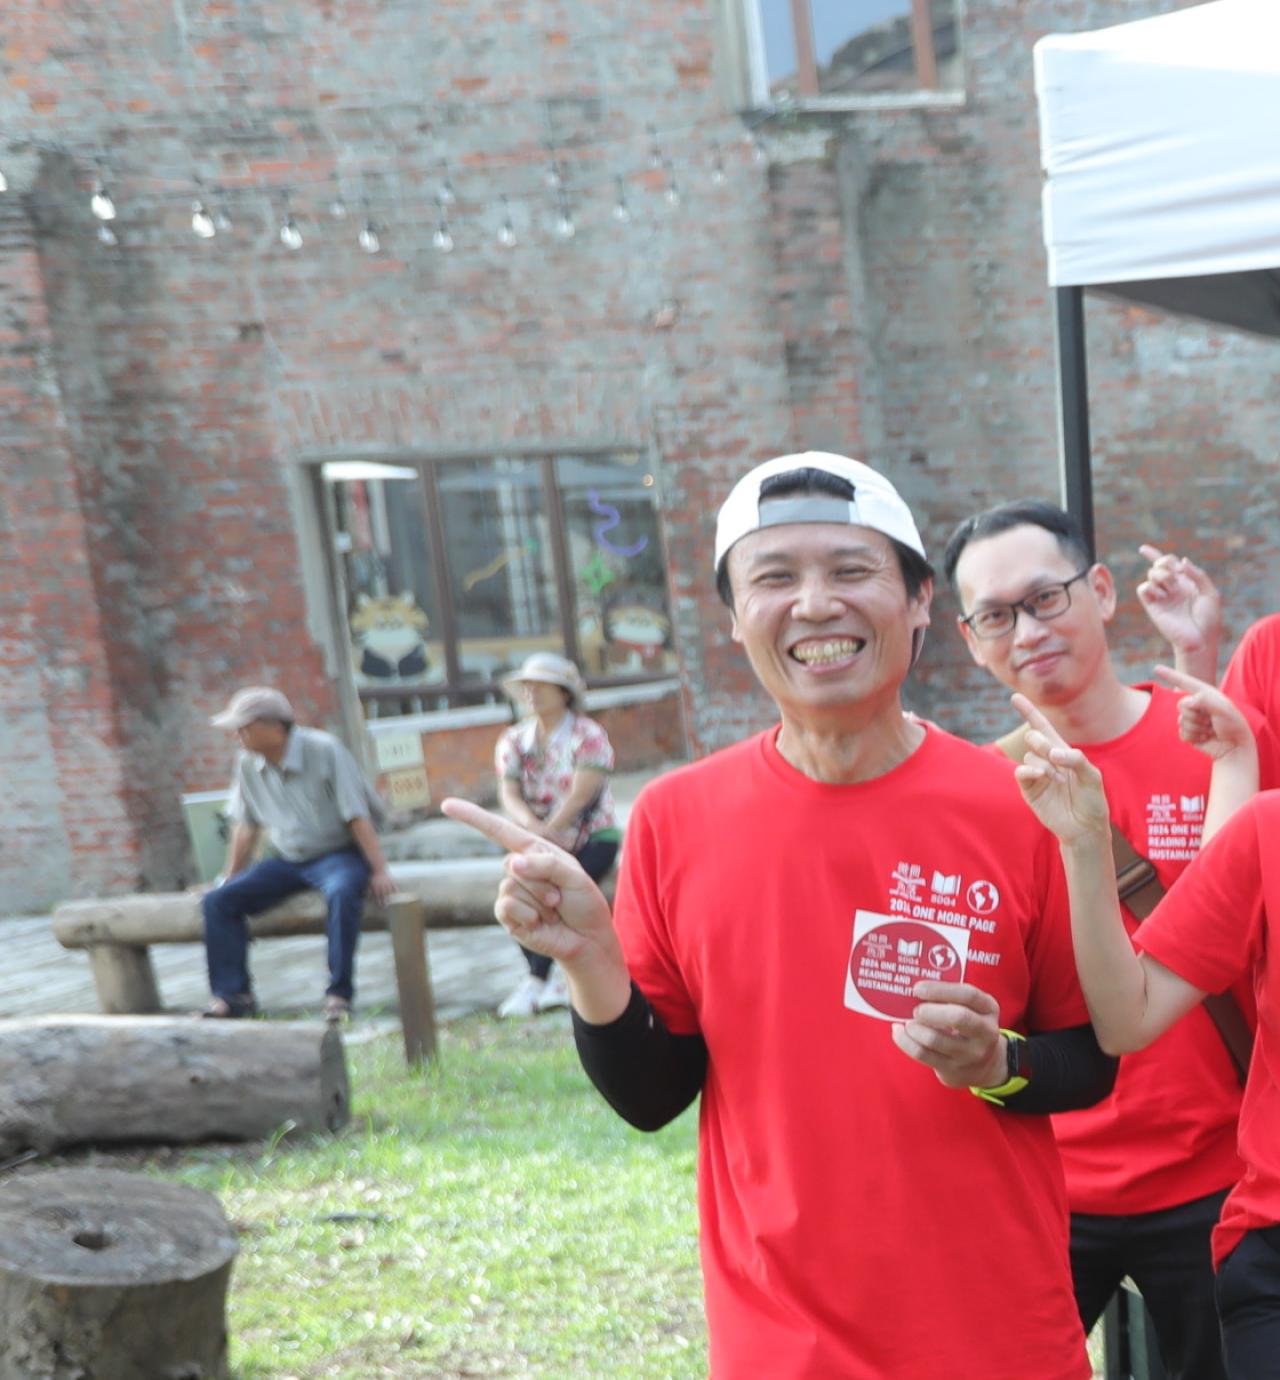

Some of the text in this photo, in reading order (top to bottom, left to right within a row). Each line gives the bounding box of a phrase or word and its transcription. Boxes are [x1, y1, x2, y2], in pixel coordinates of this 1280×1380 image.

[1148, 837, 1186, 847] READING
[912, 905, 936, 921] ONE
[937, 910, 968, 928] MORE
[969, 916, 996, 934] PAGE
[859, 967, 911, 985] READING AND
[880, 960, 897, 972] ONE
[897, 964, 921, 977] MORE
[921, 968, 941, 980] PAGE
